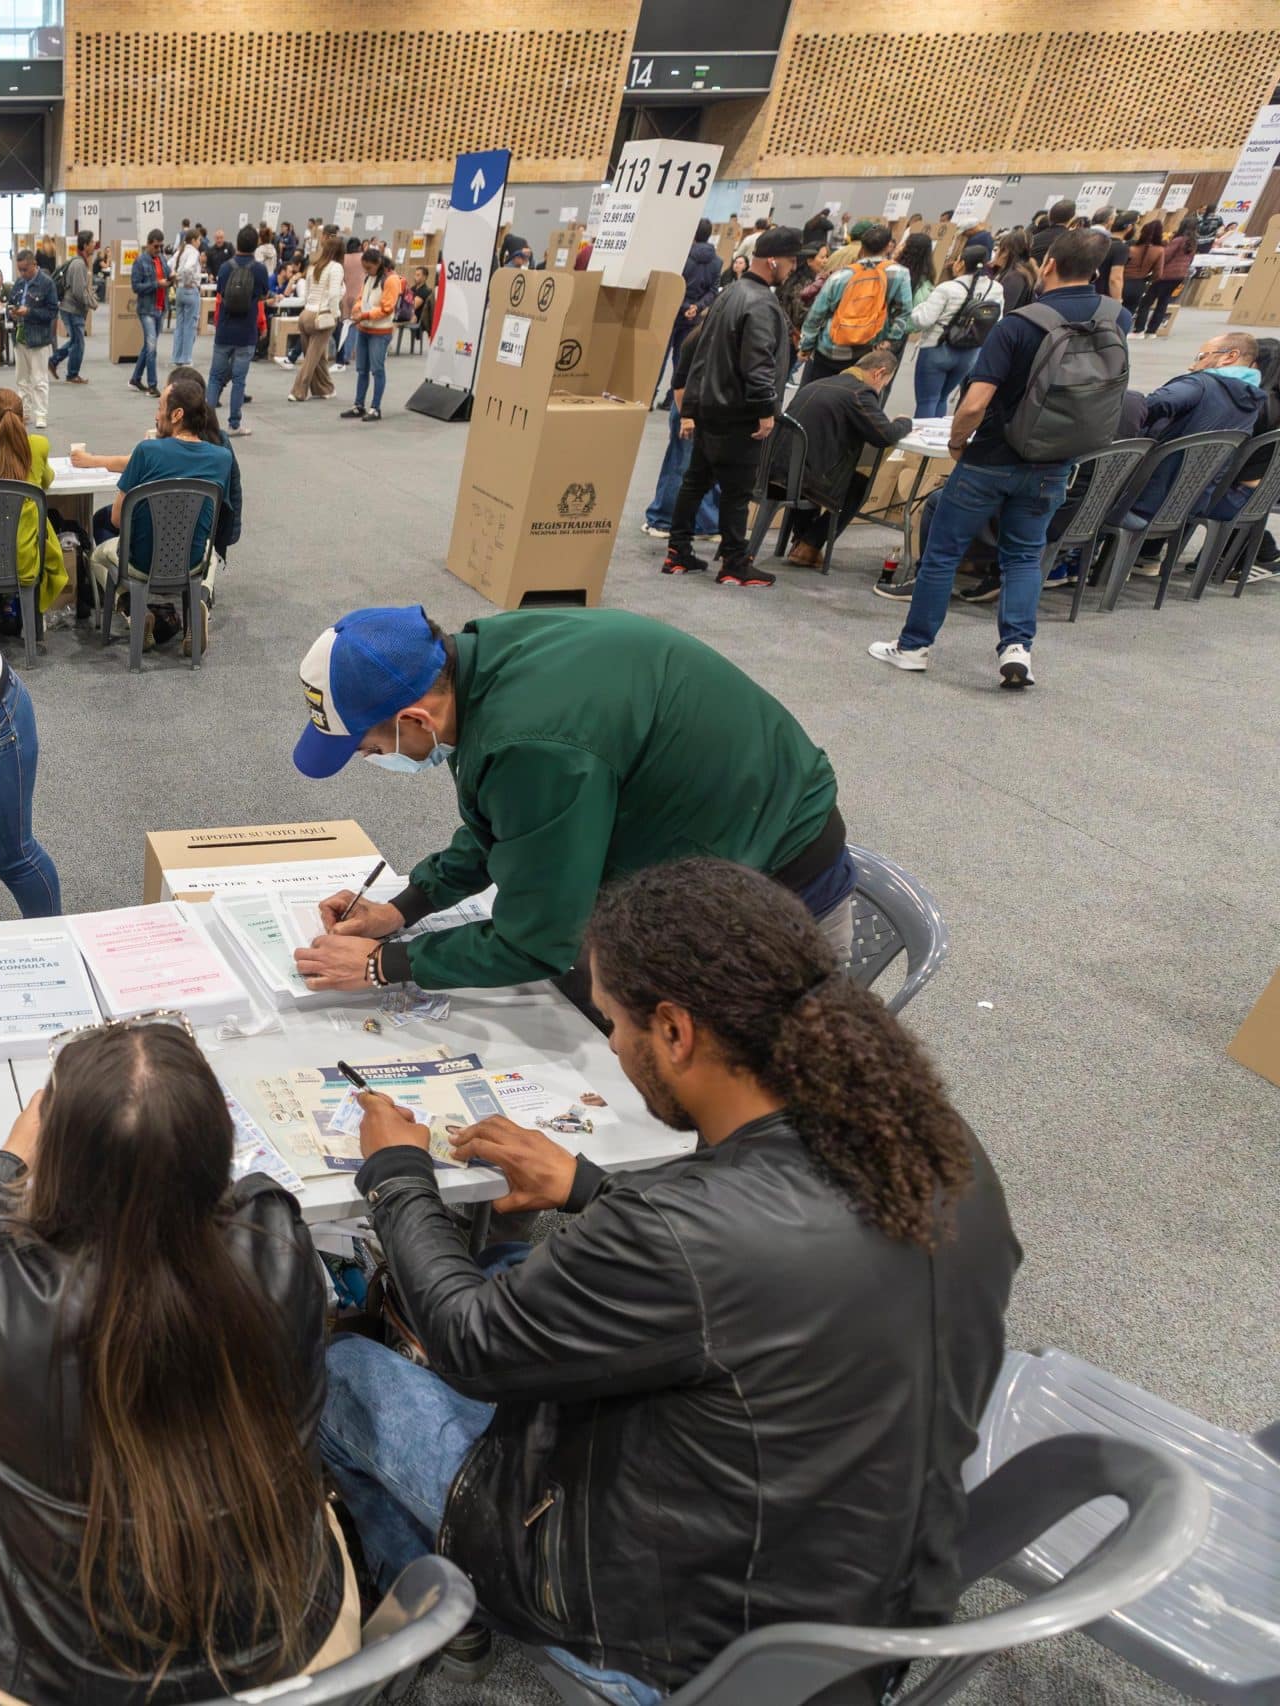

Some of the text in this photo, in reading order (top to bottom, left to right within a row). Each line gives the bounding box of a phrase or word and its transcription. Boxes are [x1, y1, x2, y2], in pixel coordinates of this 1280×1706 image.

[631, 58, 654, 88] 14
[615, 158, 651, 193] 113
[657, 159, 712, 199] 113
[965, 185, 982, 197] 139
[1081, 186, 1096, 196] 147
[1097, 186, 1113, 196] 147
[83, 205, 98, 216] 120
[141, 200, 161, 213] 121
[447, 259, 482, 282] Salida
[531, 518, 612, 530] REGISTRADURÍA
[191, 831, 247, 841] DEPOSITE
[249, 830, 263, 840] SU
[266, 829, 296, 837] VOTO
[0, 962, 60, 971] CONSULTAS
[338, 1065, 421, 1077] VERTENCIA
[498, 1085, 538, 1096] JURADO
